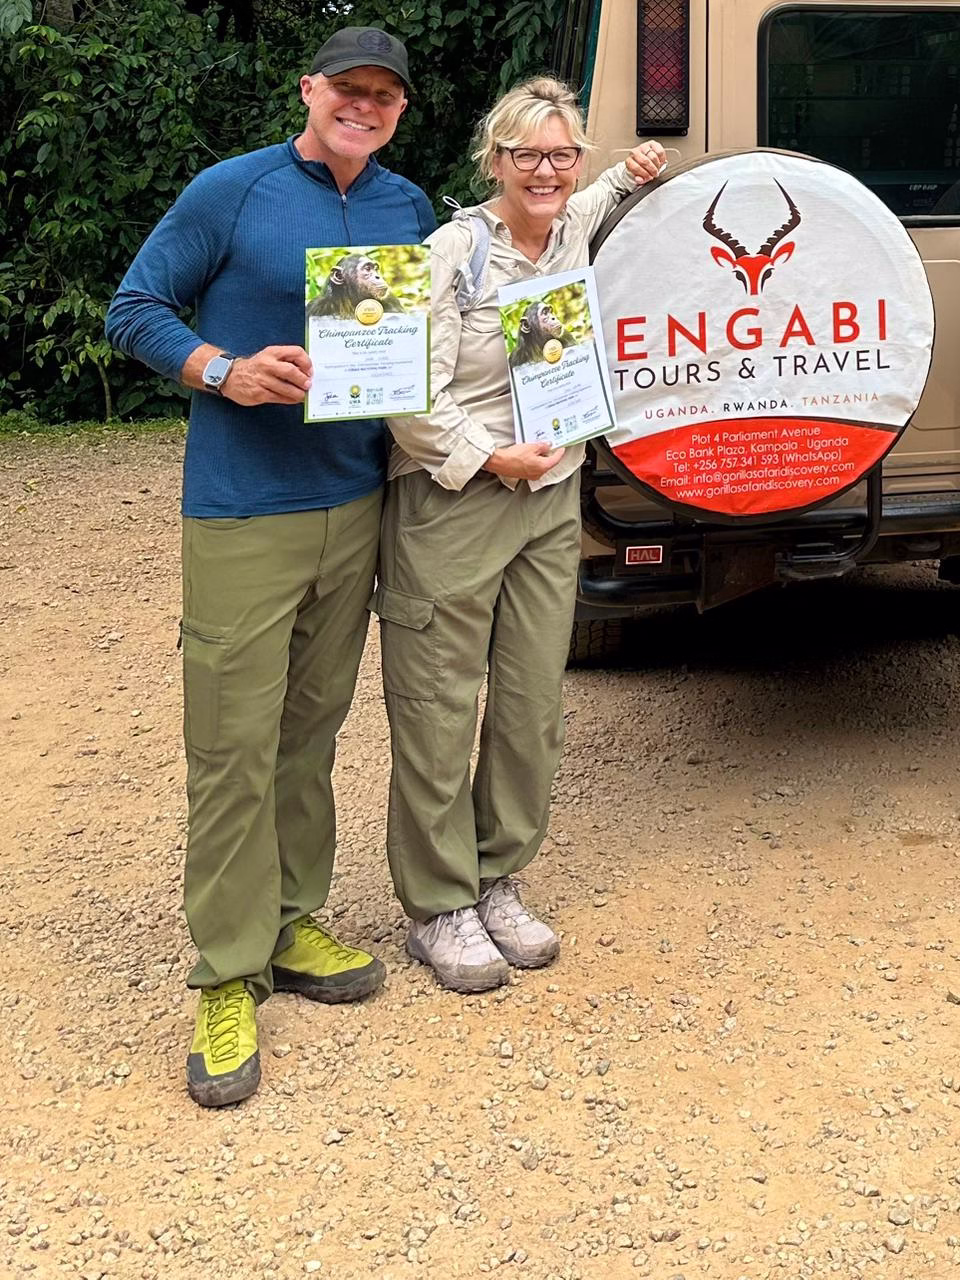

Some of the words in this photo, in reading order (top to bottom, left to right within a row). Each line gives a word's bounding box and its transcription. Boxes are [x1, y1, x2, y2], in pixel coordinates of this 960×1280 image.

[319, 328, 377, 339] Chimpanzee
[377, 325, 418, 336] Tracking
[616, 298, 887, 362] ENGABI
[344, 337, 394, 350] Certificate
[521, 365, 561, 386] Chimpanzee
[562, 353, 590, 370] Tracking
[540, 370, 575, 388] Certificate
[614, 361, 721, 391] TOURS
[738, 357, 756, 379] &
[773, 349, 890, 377] TRAVEL
[802, 392, 879, 406] TANZANIA
[691, 434, 711, 445] Plot
[713, 432, 720, 442] 4
[722, 429, 778, 442] Parliament
[780, 426, 821, 437] Avenue
[666, 449, 686, 460] Eco
[689, 445, 714, 458] Bank
[750, 440, 798, 454] Kampala
[806, 437, 849, 450] Uganda
[673, 462, 690, 473] Tel:
[693, 460, 718, 471] +256
[720, 458, 738, 468] 757
[740, 456, 757, 467] 341
[760, 455, 779, 465] 593
[781, 449, 842, 465] (WhatsApp)
[660, 474, 692, 488] Email:
[693, 461, 855, 485] info@gorillasafaridiscovery.com
[676, 475, 840, 498] www.gorillasafaridiscovery.com
